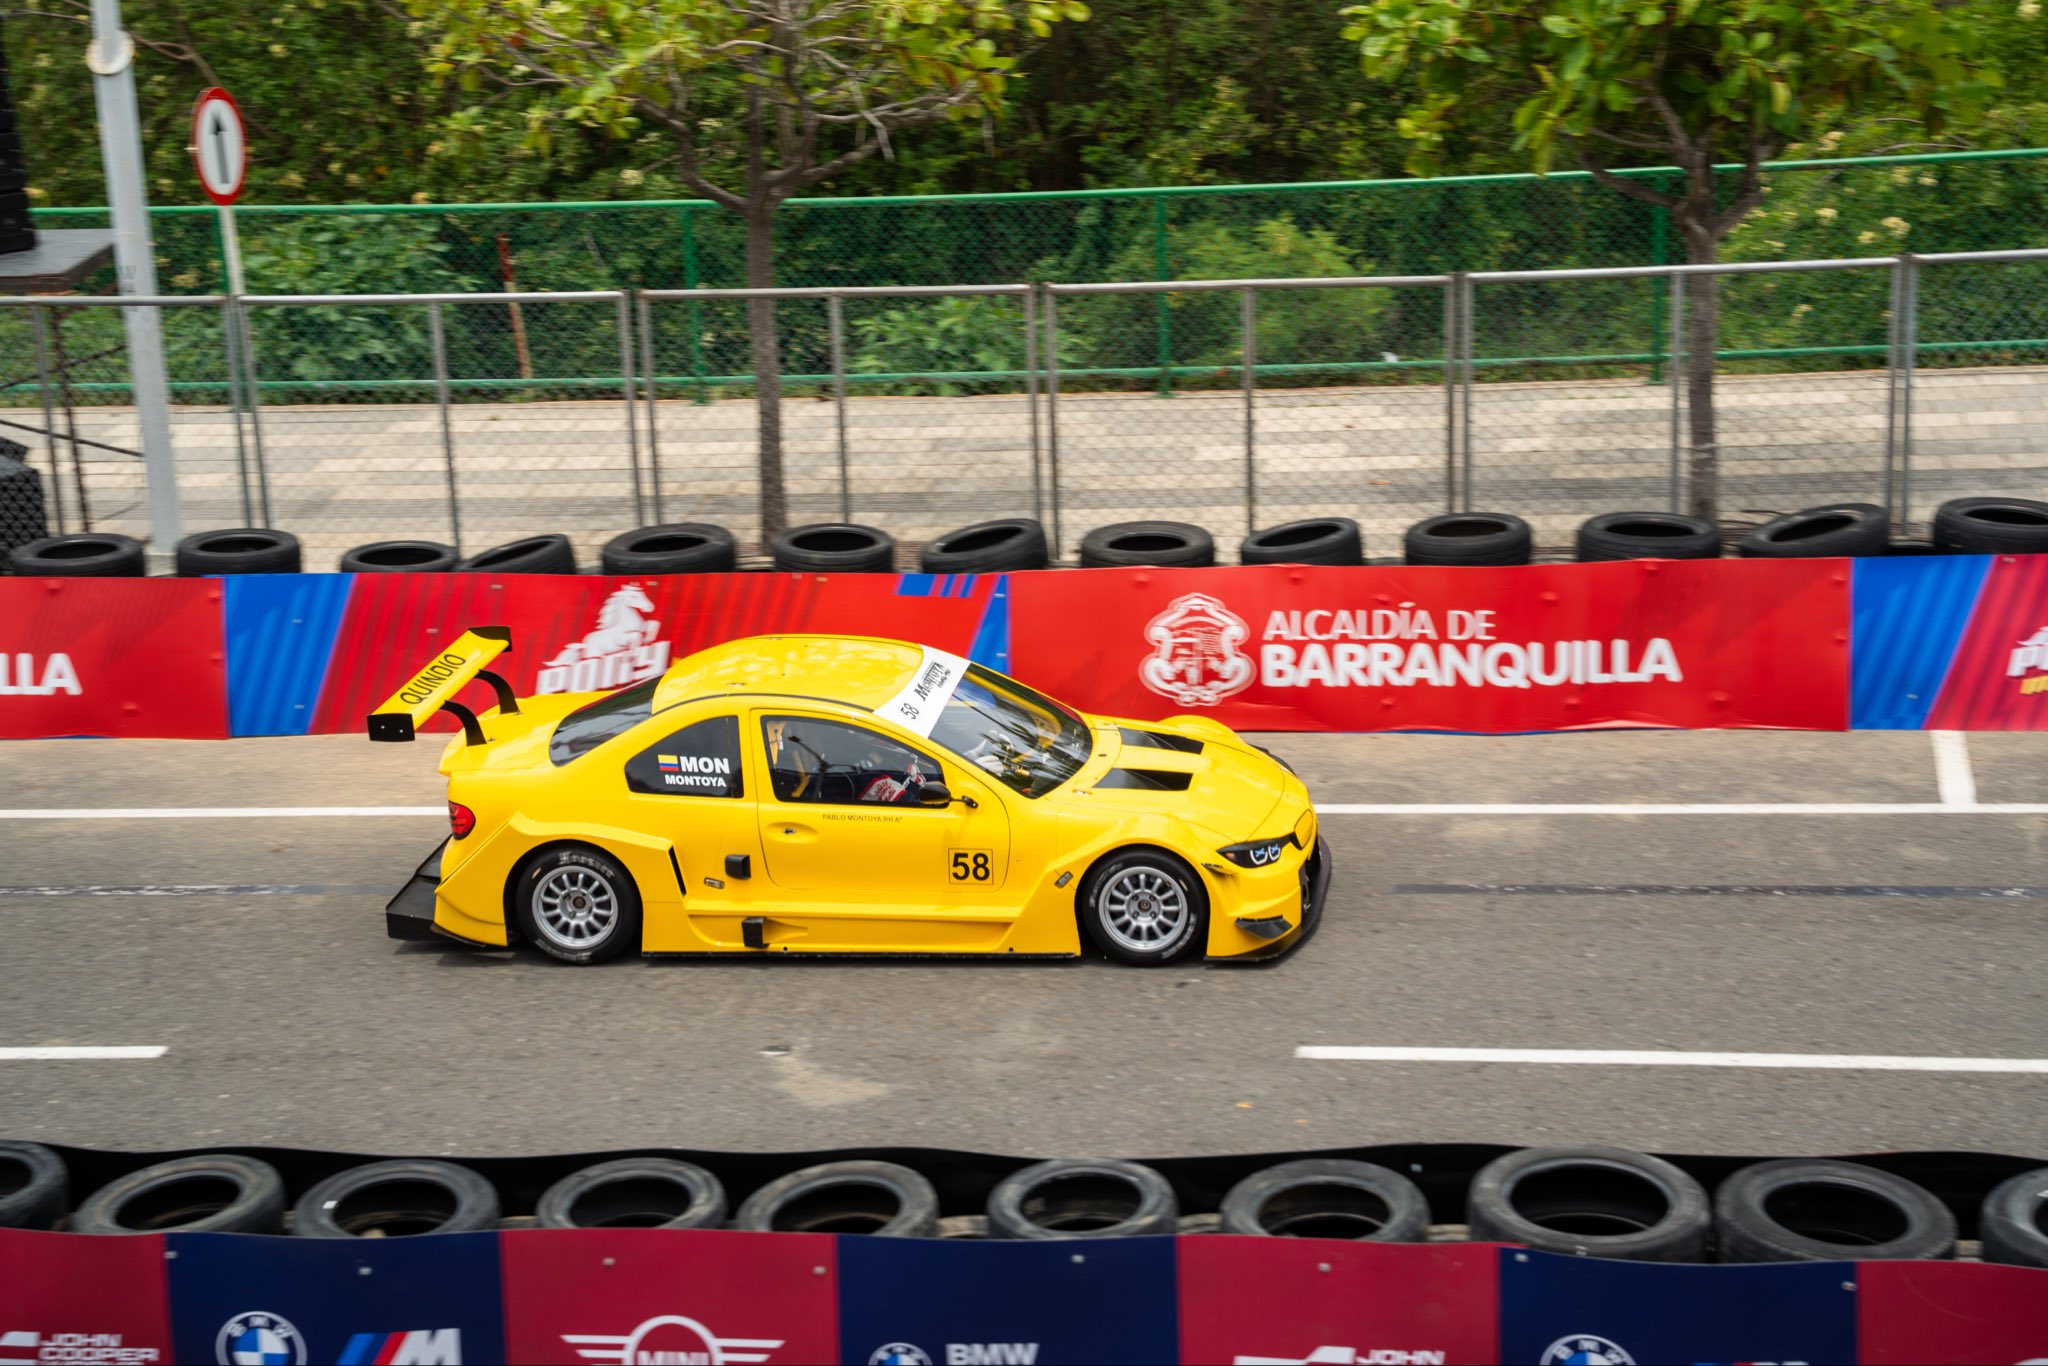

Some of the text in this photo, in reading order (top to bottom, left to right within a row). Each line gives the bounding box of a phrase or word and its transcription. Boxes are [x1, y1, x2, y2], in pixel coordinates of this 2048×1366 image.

[1262, 601, 1496, 641] ALCALDÍA DE
[1260, 637, 1683, 688] BARRANQUILLA
[400, 653, 466, 705] QUINDIO
[900, 702, 919, 719] 58
[680, 756, 731, 774] MON
[664, 774, 727, 787] MONTOYA
[822, 813, 846, 821] PABLO
[952, 852, 990, 881] 58
[39, 1333, 122, 1347] JOHN
[39, 1347, 160, 1361] COOPER
[945, 1343, 1040, 1366] BMW
[1355, 1349, 1446, 1365] JOHN
